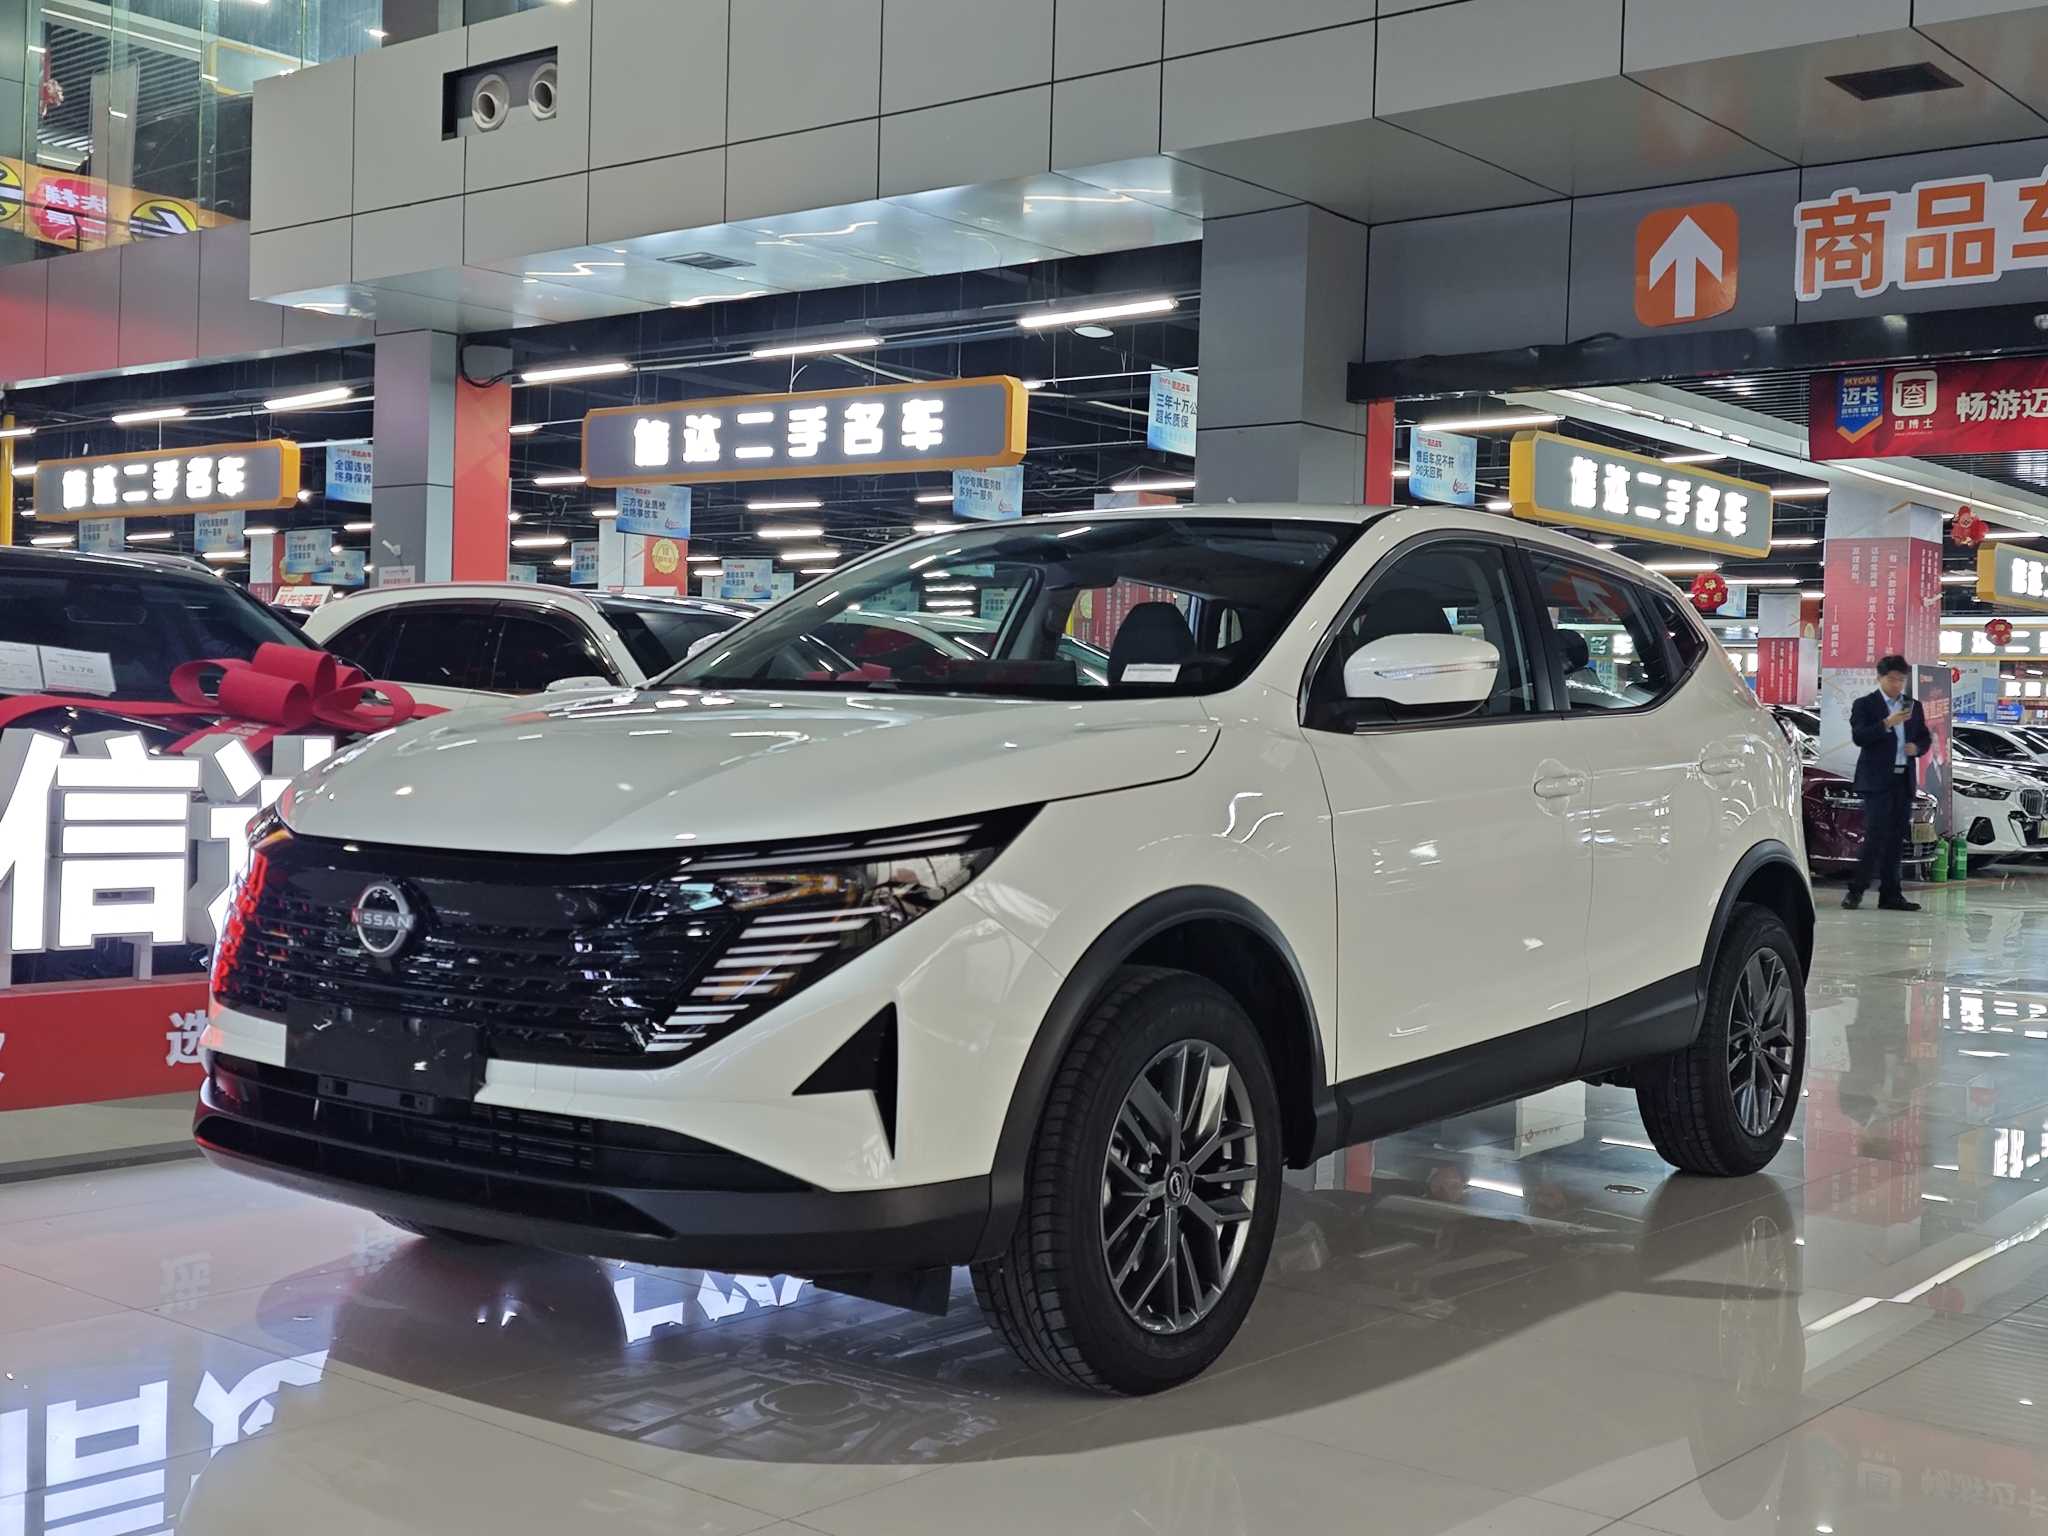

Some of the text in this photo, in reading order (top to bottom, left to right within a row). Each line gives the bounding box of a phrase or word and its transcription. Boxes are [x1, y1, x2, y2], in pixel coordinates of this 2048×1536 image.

[1841, 386, 1879, 405] 迈卡
[634, 398, 945, 467] 信达二手名车
[1570, 455, 1748, 538] 信达二手名车
[351, 904, 414, 930] NISSAN
